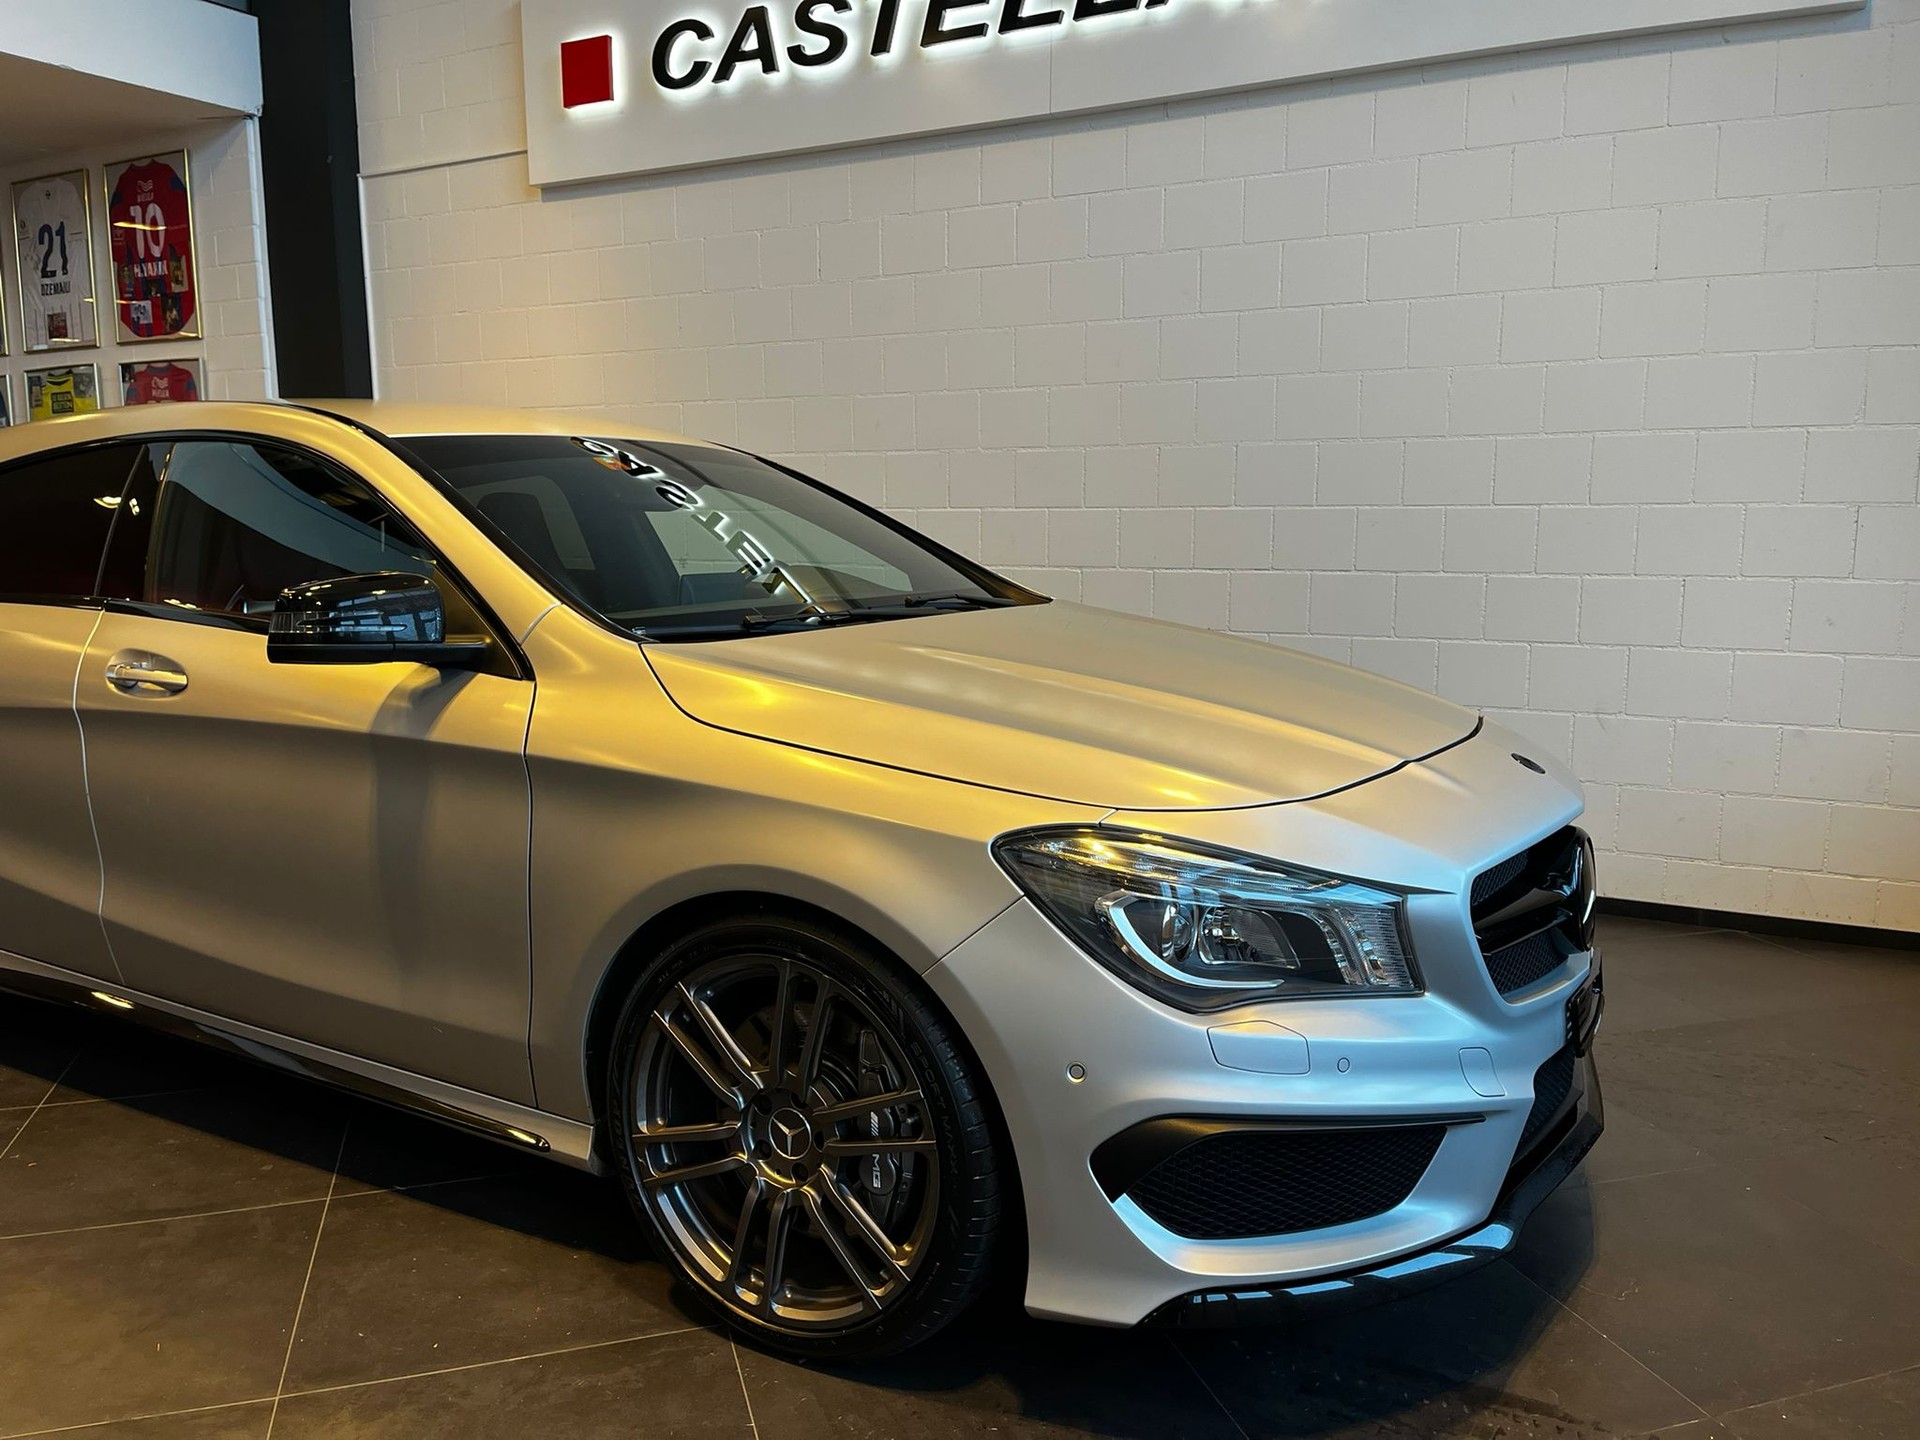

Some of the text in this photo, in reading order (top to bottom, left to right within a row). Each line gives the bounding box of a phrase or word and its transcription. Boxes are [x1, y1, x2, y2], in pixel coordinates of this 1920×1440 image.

[652, 0, 1169, 90] CASTE
[38, 221, 68, 279] 21
[129, 202, 166, 259] 10
